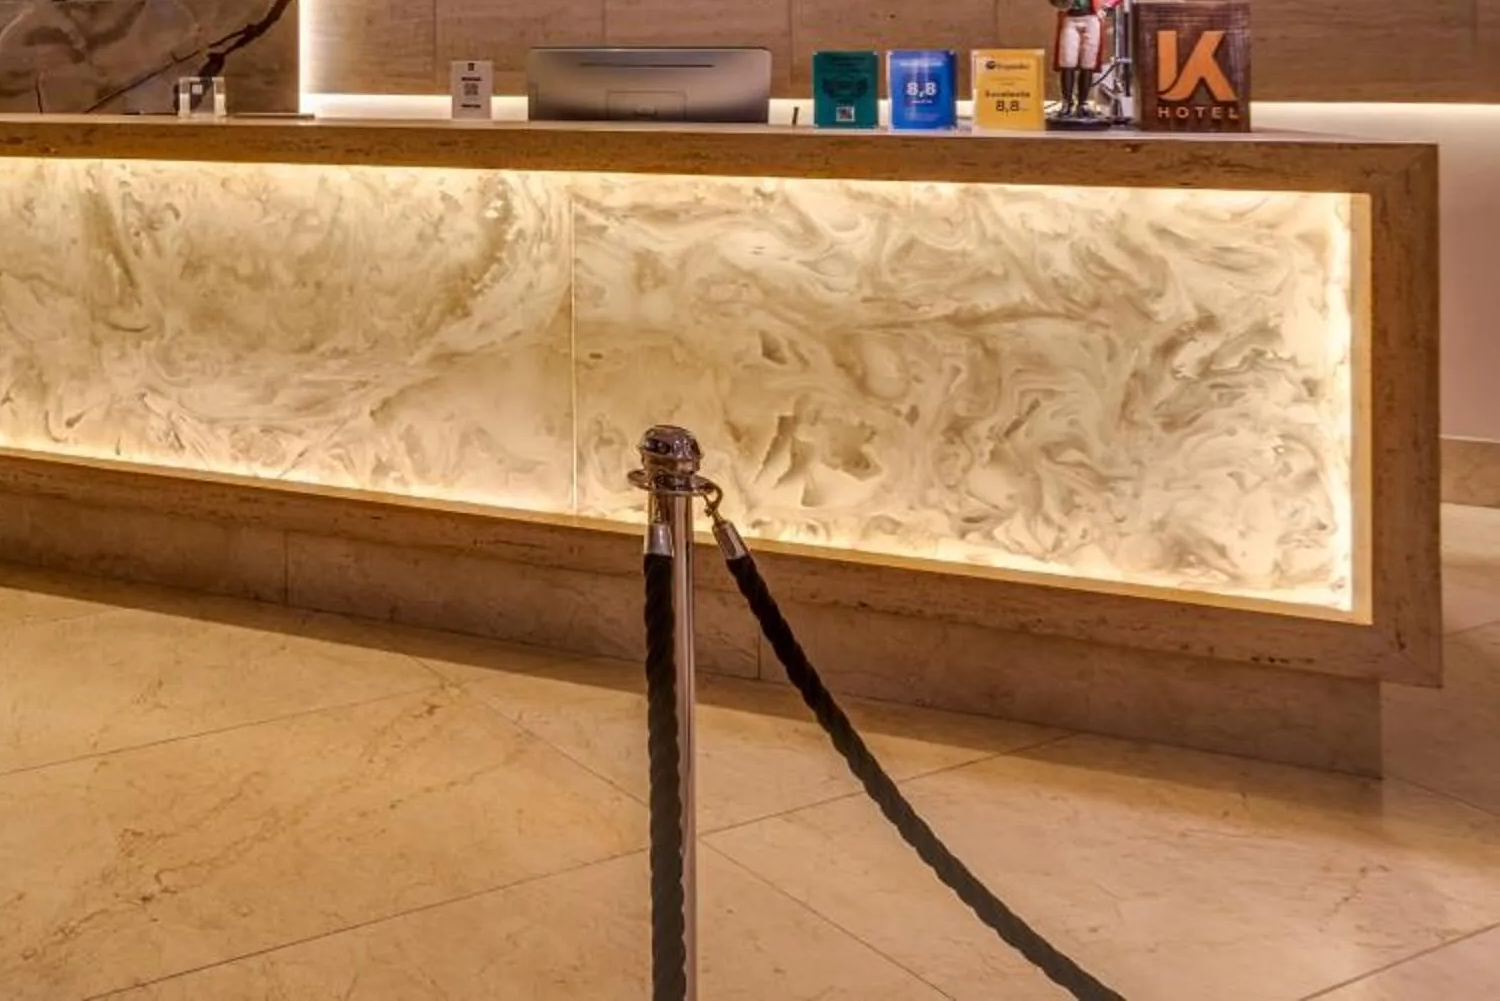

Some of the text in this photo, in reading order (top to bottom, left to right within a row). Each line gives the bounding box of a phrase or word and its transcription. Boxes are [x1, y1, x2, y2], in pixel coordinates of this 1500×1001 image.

[906, 81, 937, 99] 8,8
[995, 100, 1020, 116] 8,8
[1157, 105, 1240, 120] HOTEL
